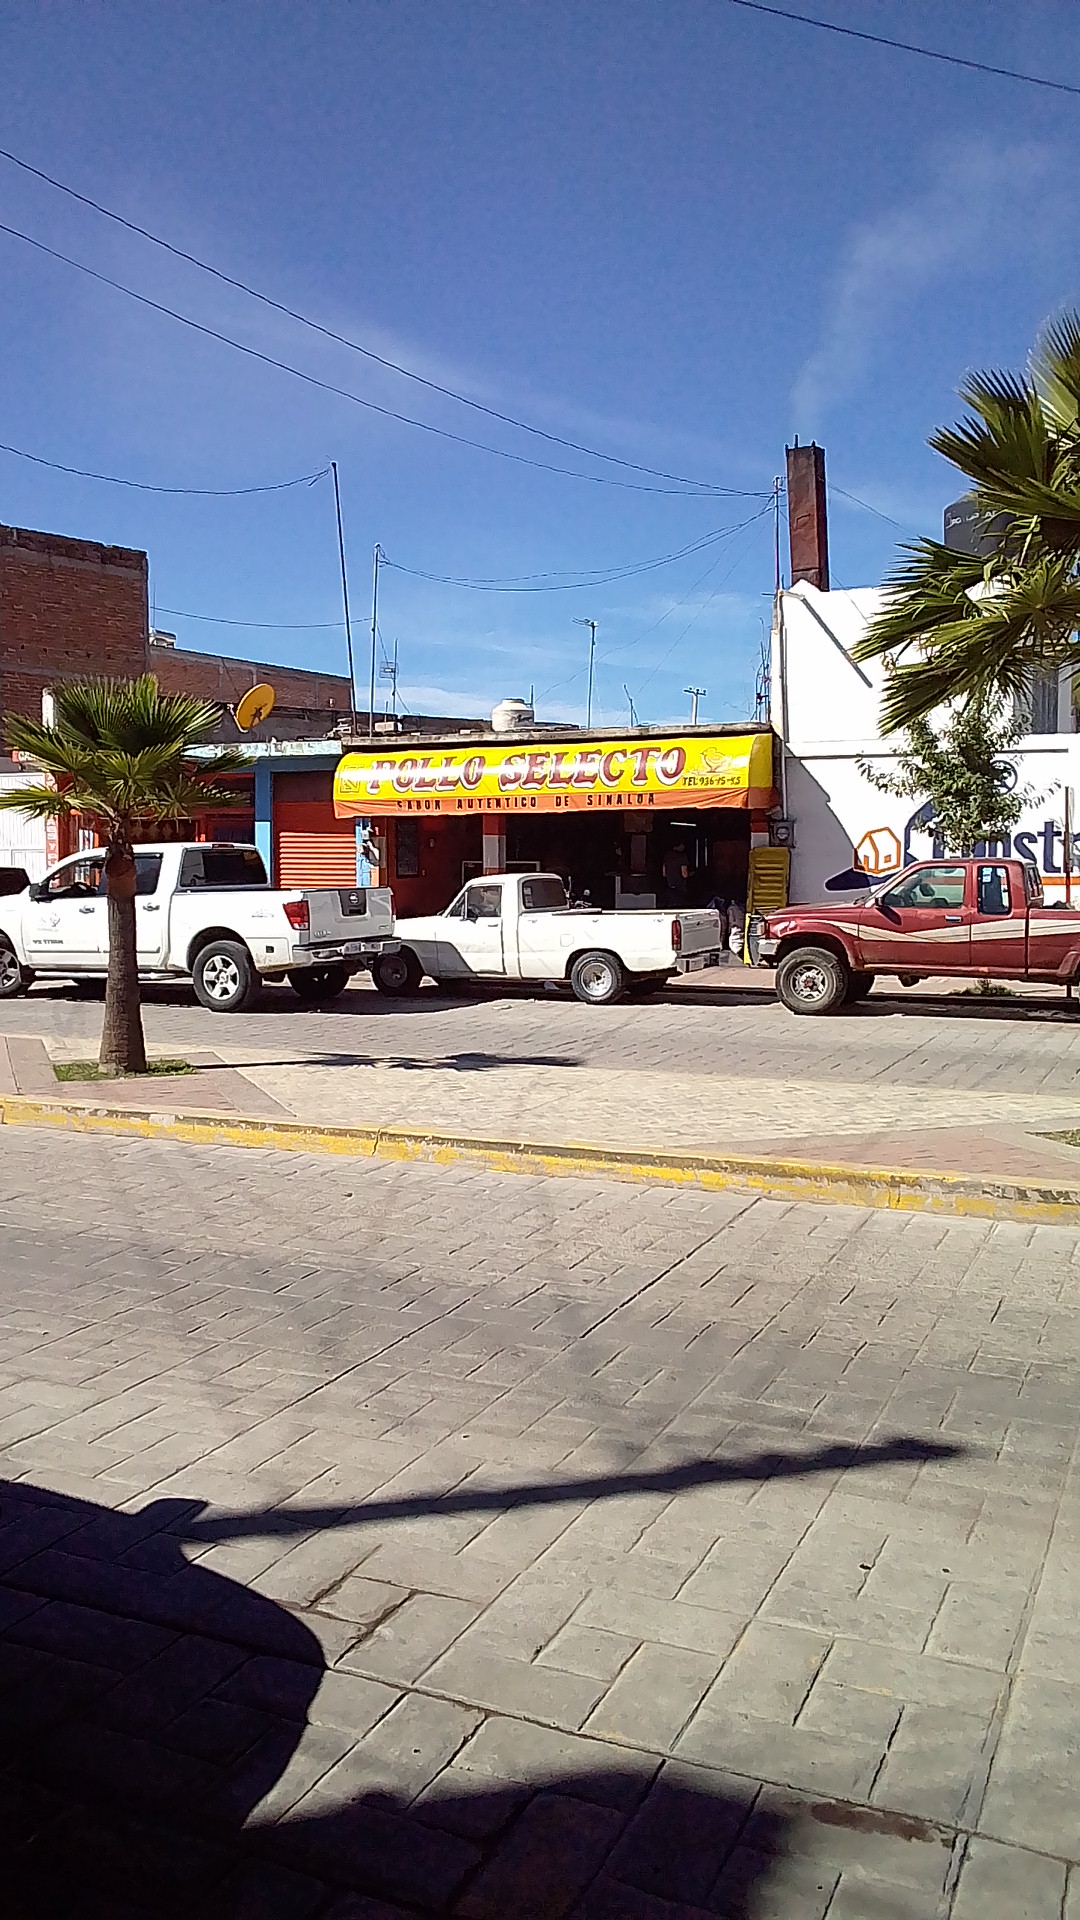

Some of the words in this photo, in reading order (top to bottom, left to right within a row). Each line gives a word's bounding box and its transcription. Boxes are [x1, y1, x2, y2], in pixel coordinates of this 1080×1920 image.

[367, 756, 486, 794] POLLO
[498, 746, 687, 791] SELECTO
[397, 799, 441, 810] SABOR
[456, 796, 537, 809] AUTENTICO
[555, 795, 570, 807] DE
[586, 792, 655, 806] SINALOA
